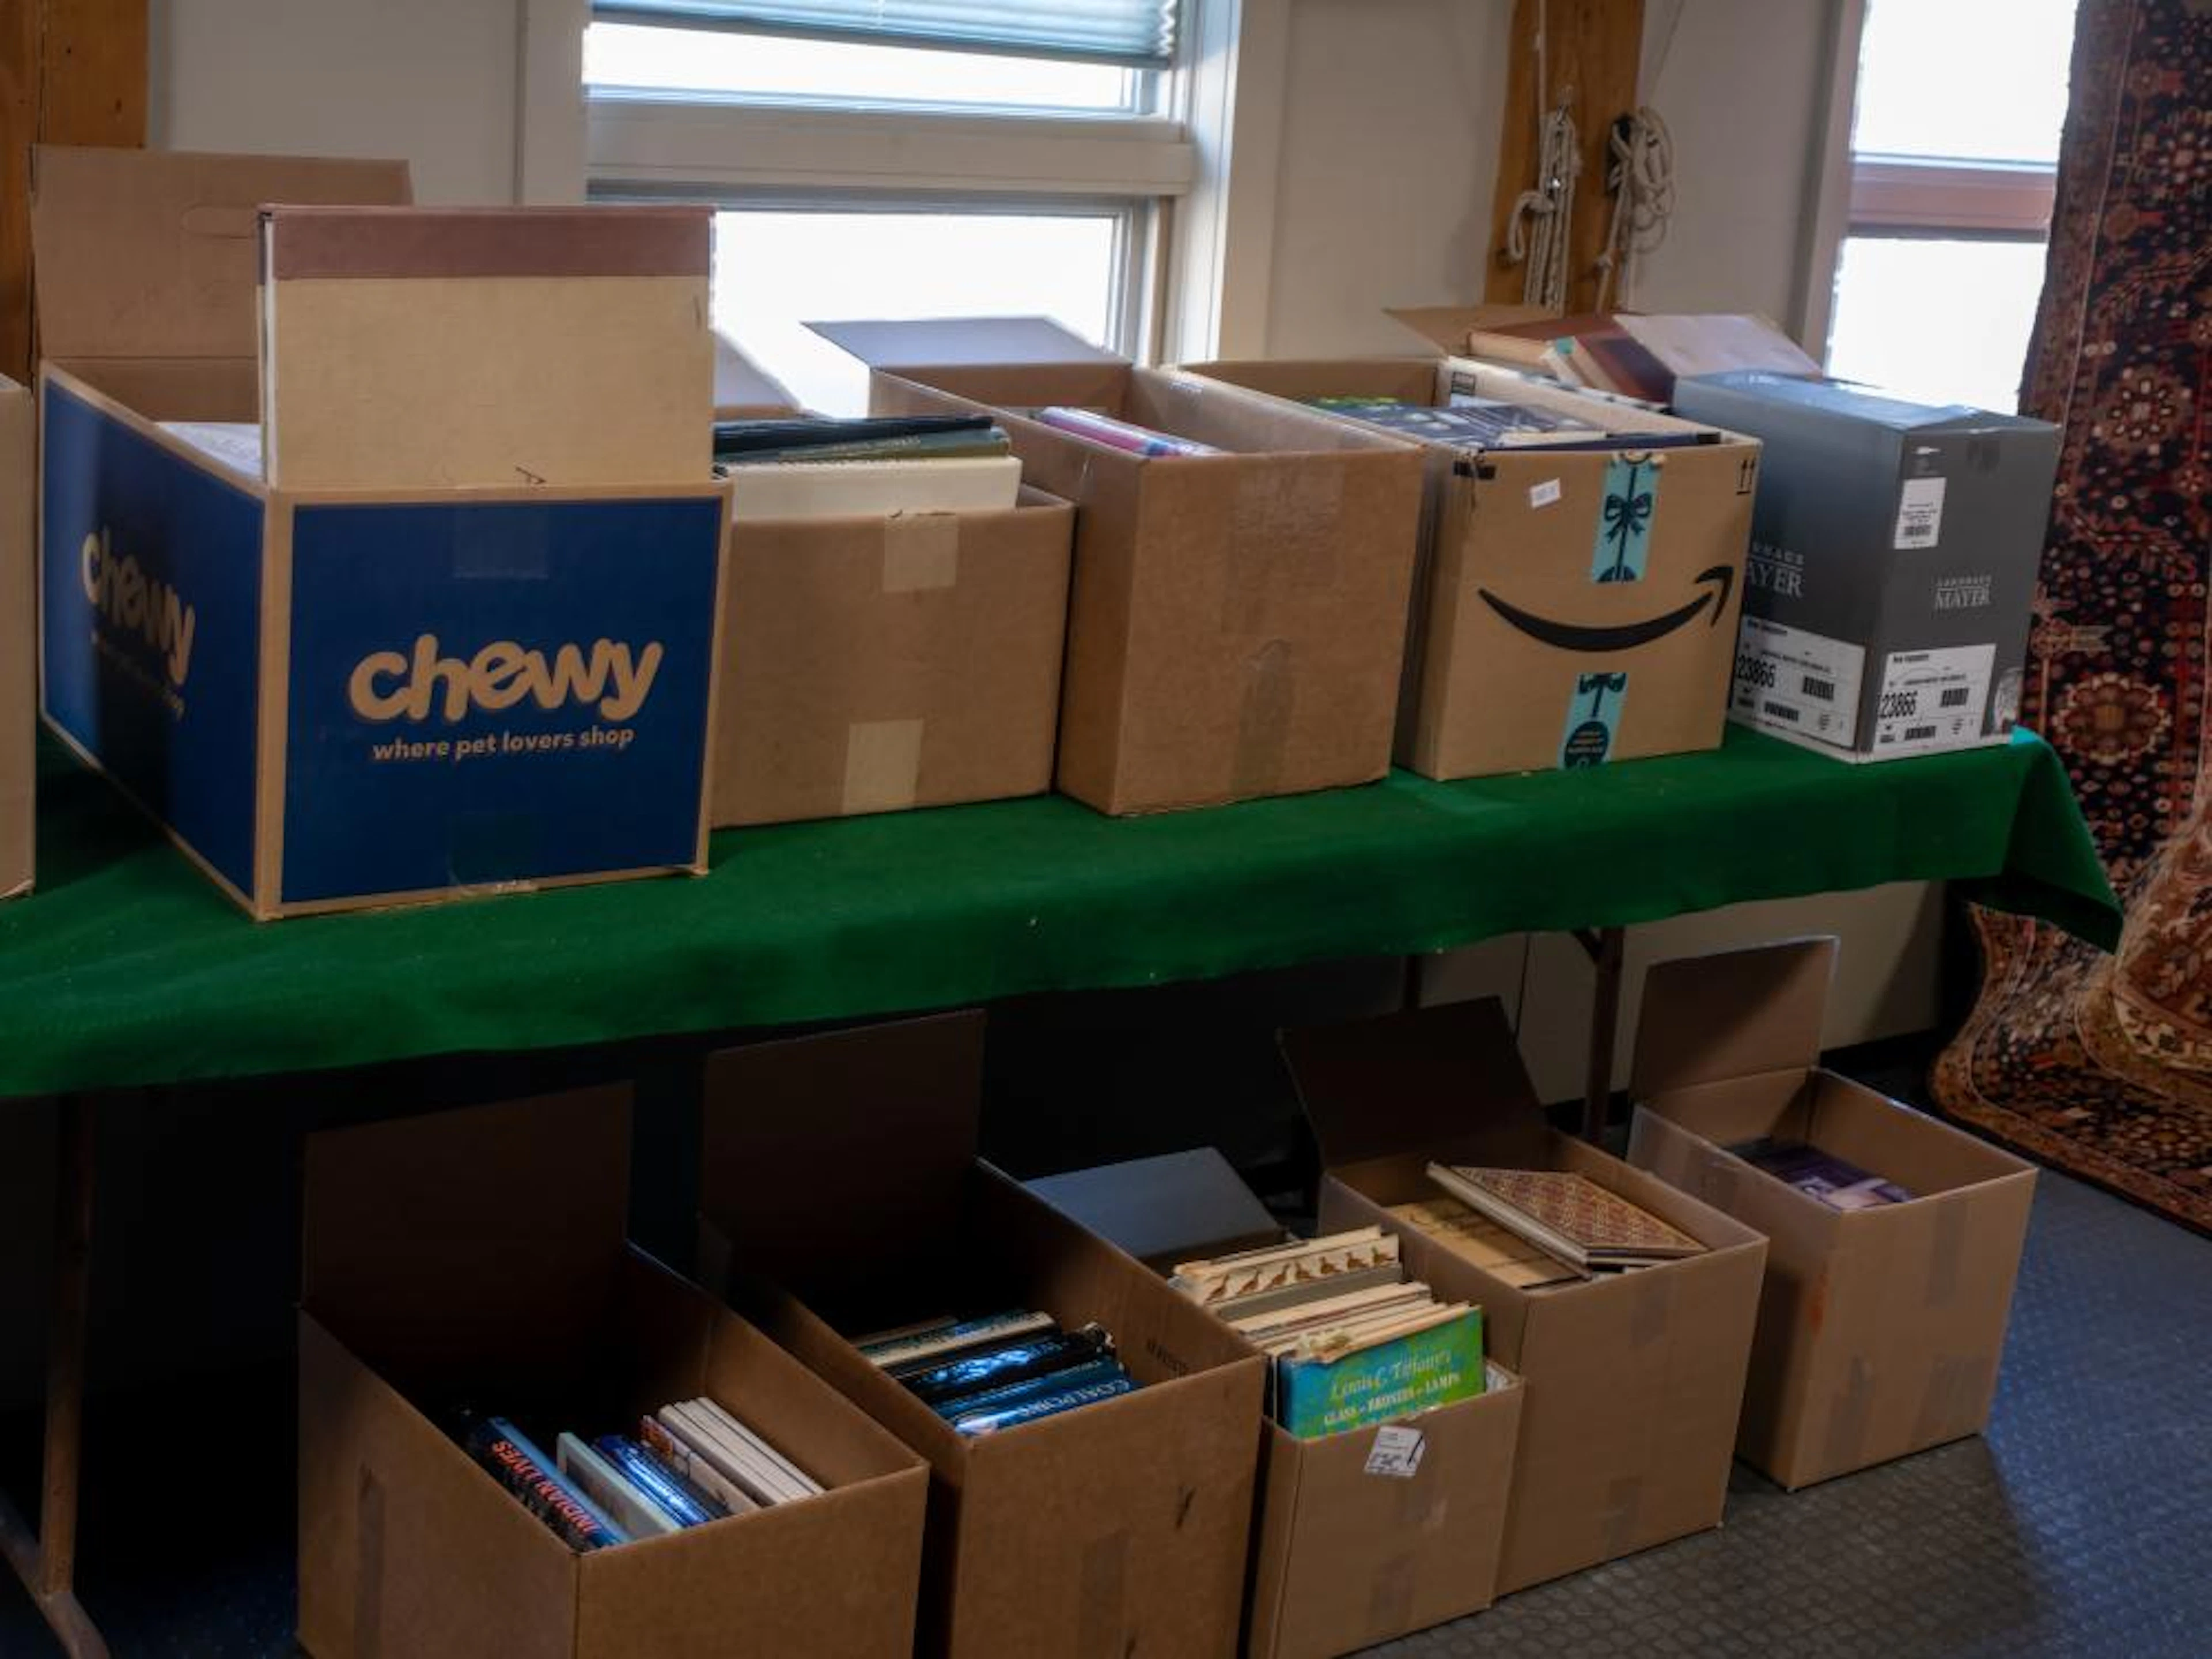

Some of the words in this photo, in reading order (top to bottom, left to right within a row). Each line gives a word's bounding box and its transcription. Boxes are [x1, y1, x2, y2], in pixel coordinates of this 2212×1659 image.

[1749, 562, 1805, 597] AYER
[82, 525, 196, 685] chewy
[1934, 586, 1990, 611] MAYER
[349, 634, 664, 722] chewy
[373, 737, 449, 760] where
[455, 733, 496, 760] pet
[502, 730, 574, 753] lovers
[580, 725, 634, 748] shop
